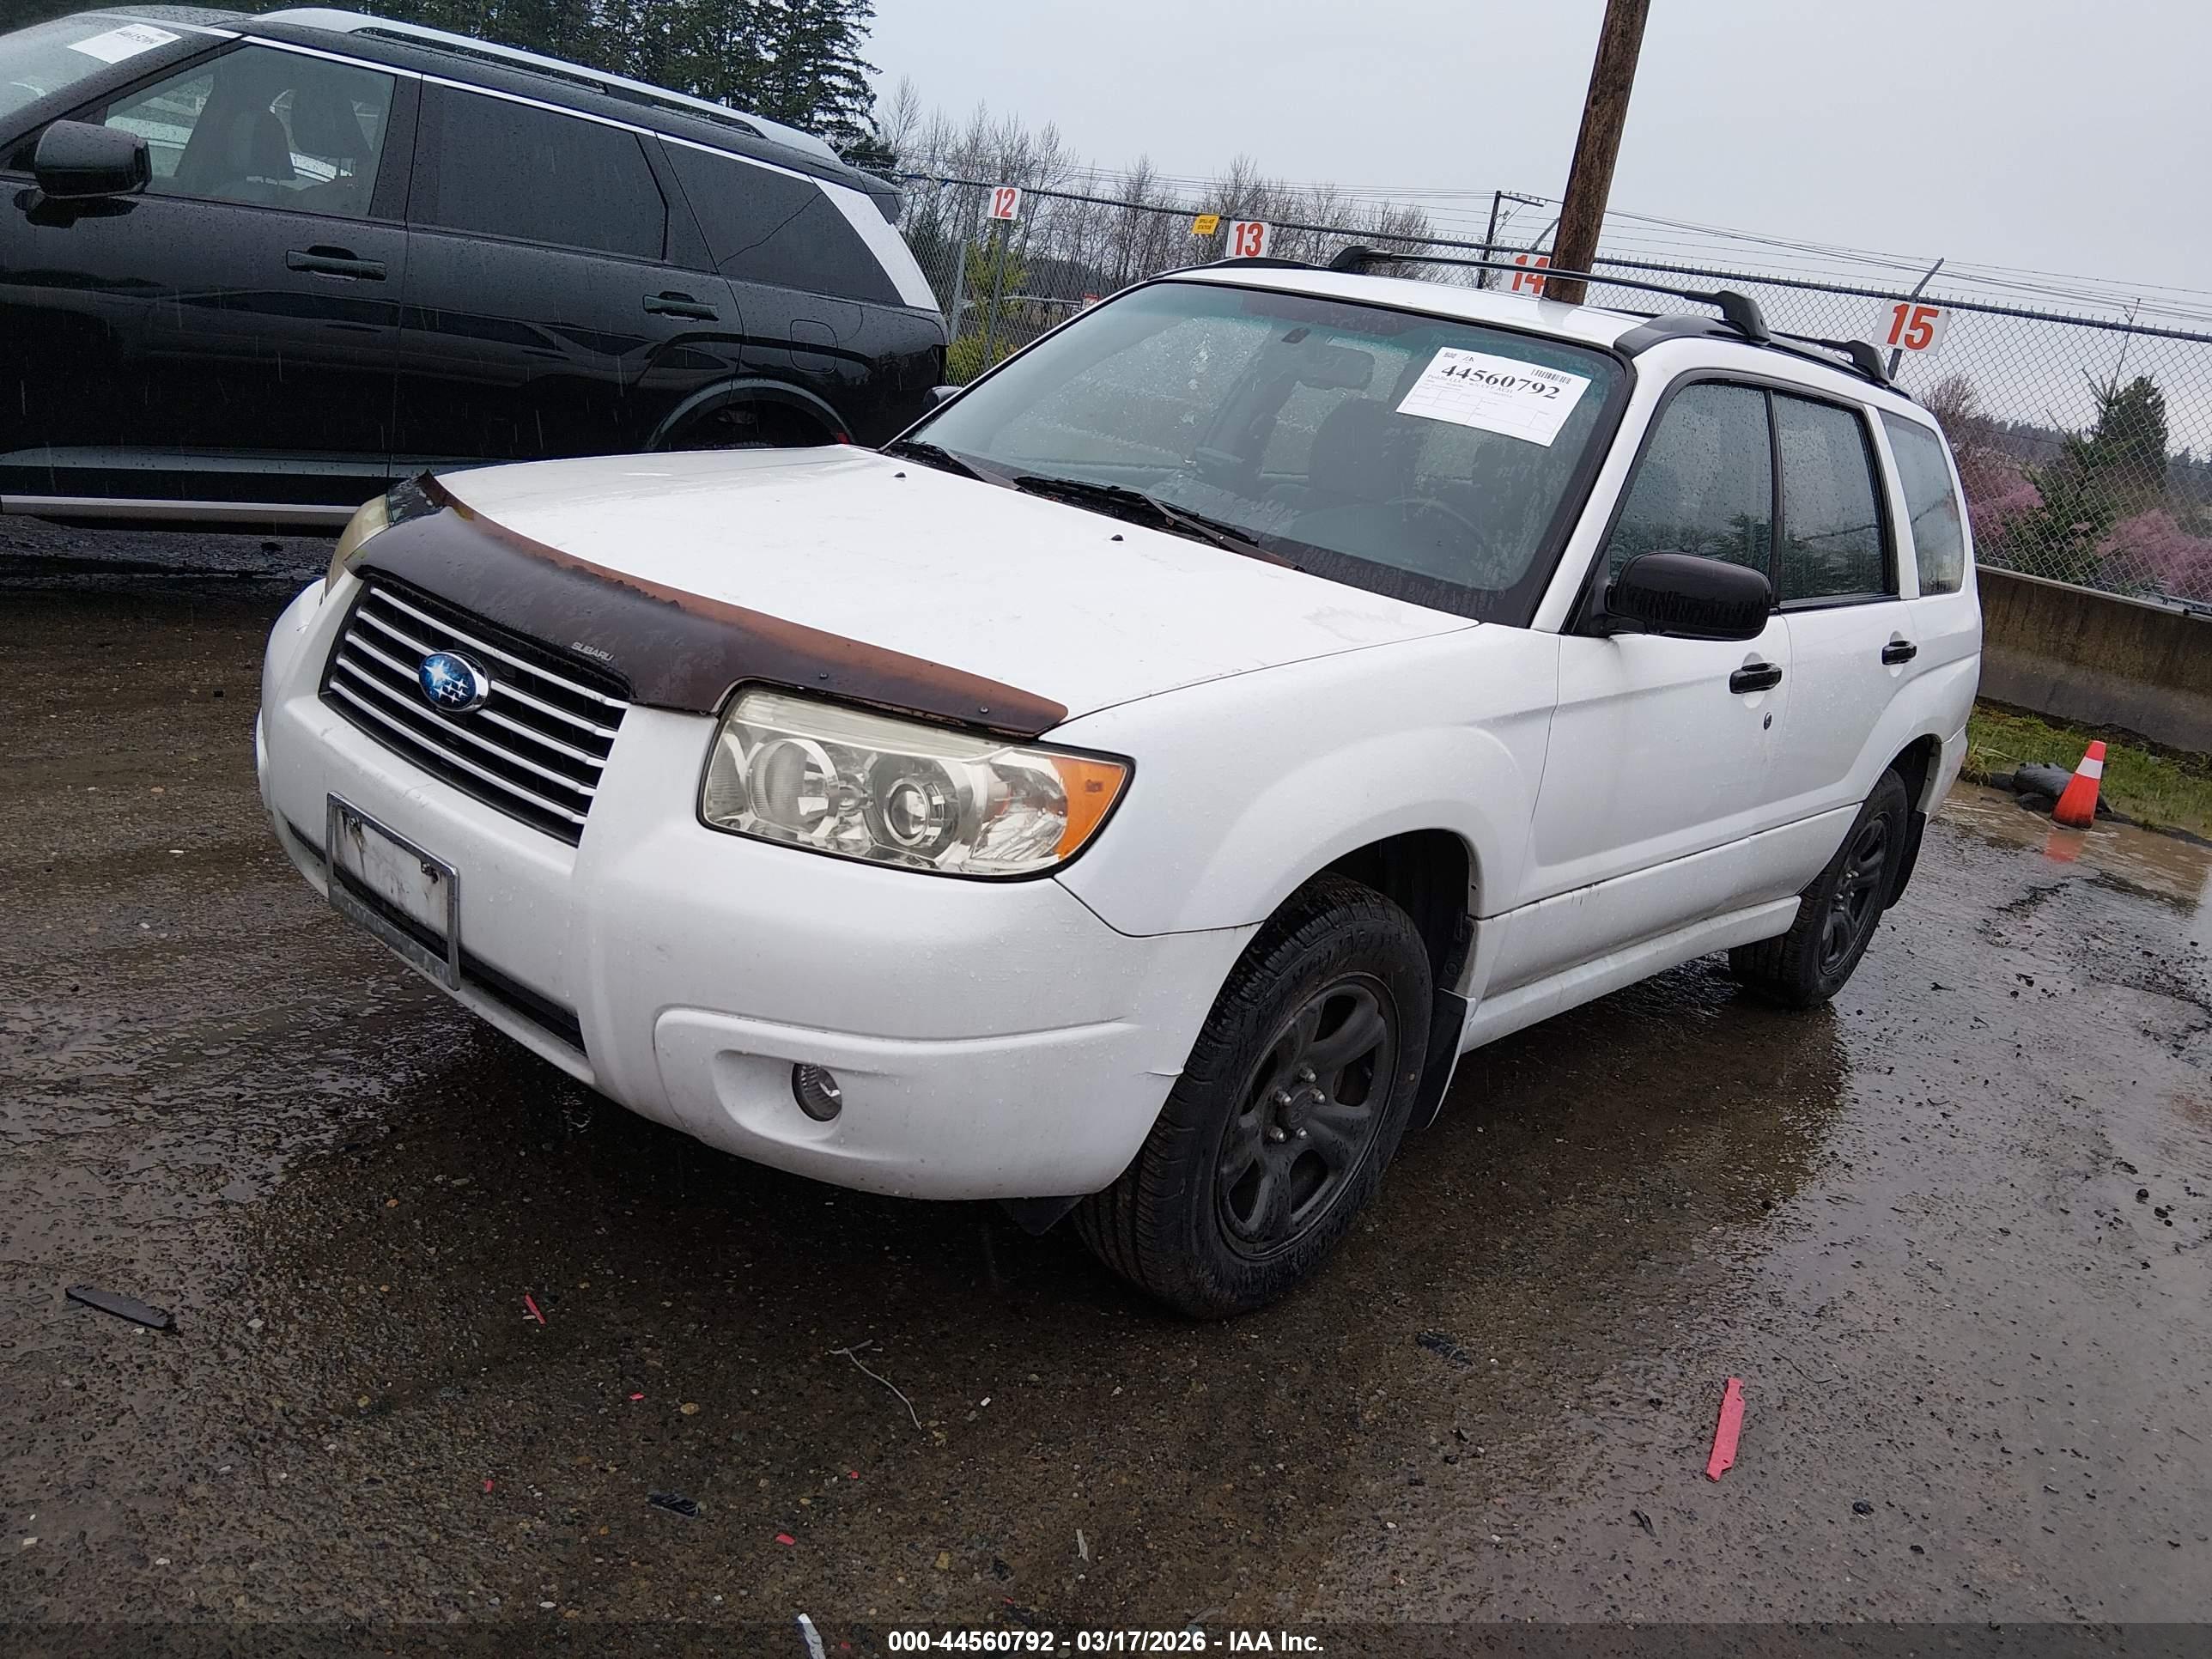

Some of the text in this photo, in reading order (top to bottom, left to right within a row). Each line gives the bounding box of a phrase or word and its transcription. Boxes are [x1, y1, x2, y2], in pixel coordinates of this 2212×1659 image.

[994, 188, 1016, 217] 12
[1236, 223, 1264, 257] 13
[1512, 254, 1549, 295] 14
[1887, 303, 1940, 350] 15
[1441, 364, 1561, 399] 44560792
[571, 641, 615, 661] SUBARU
